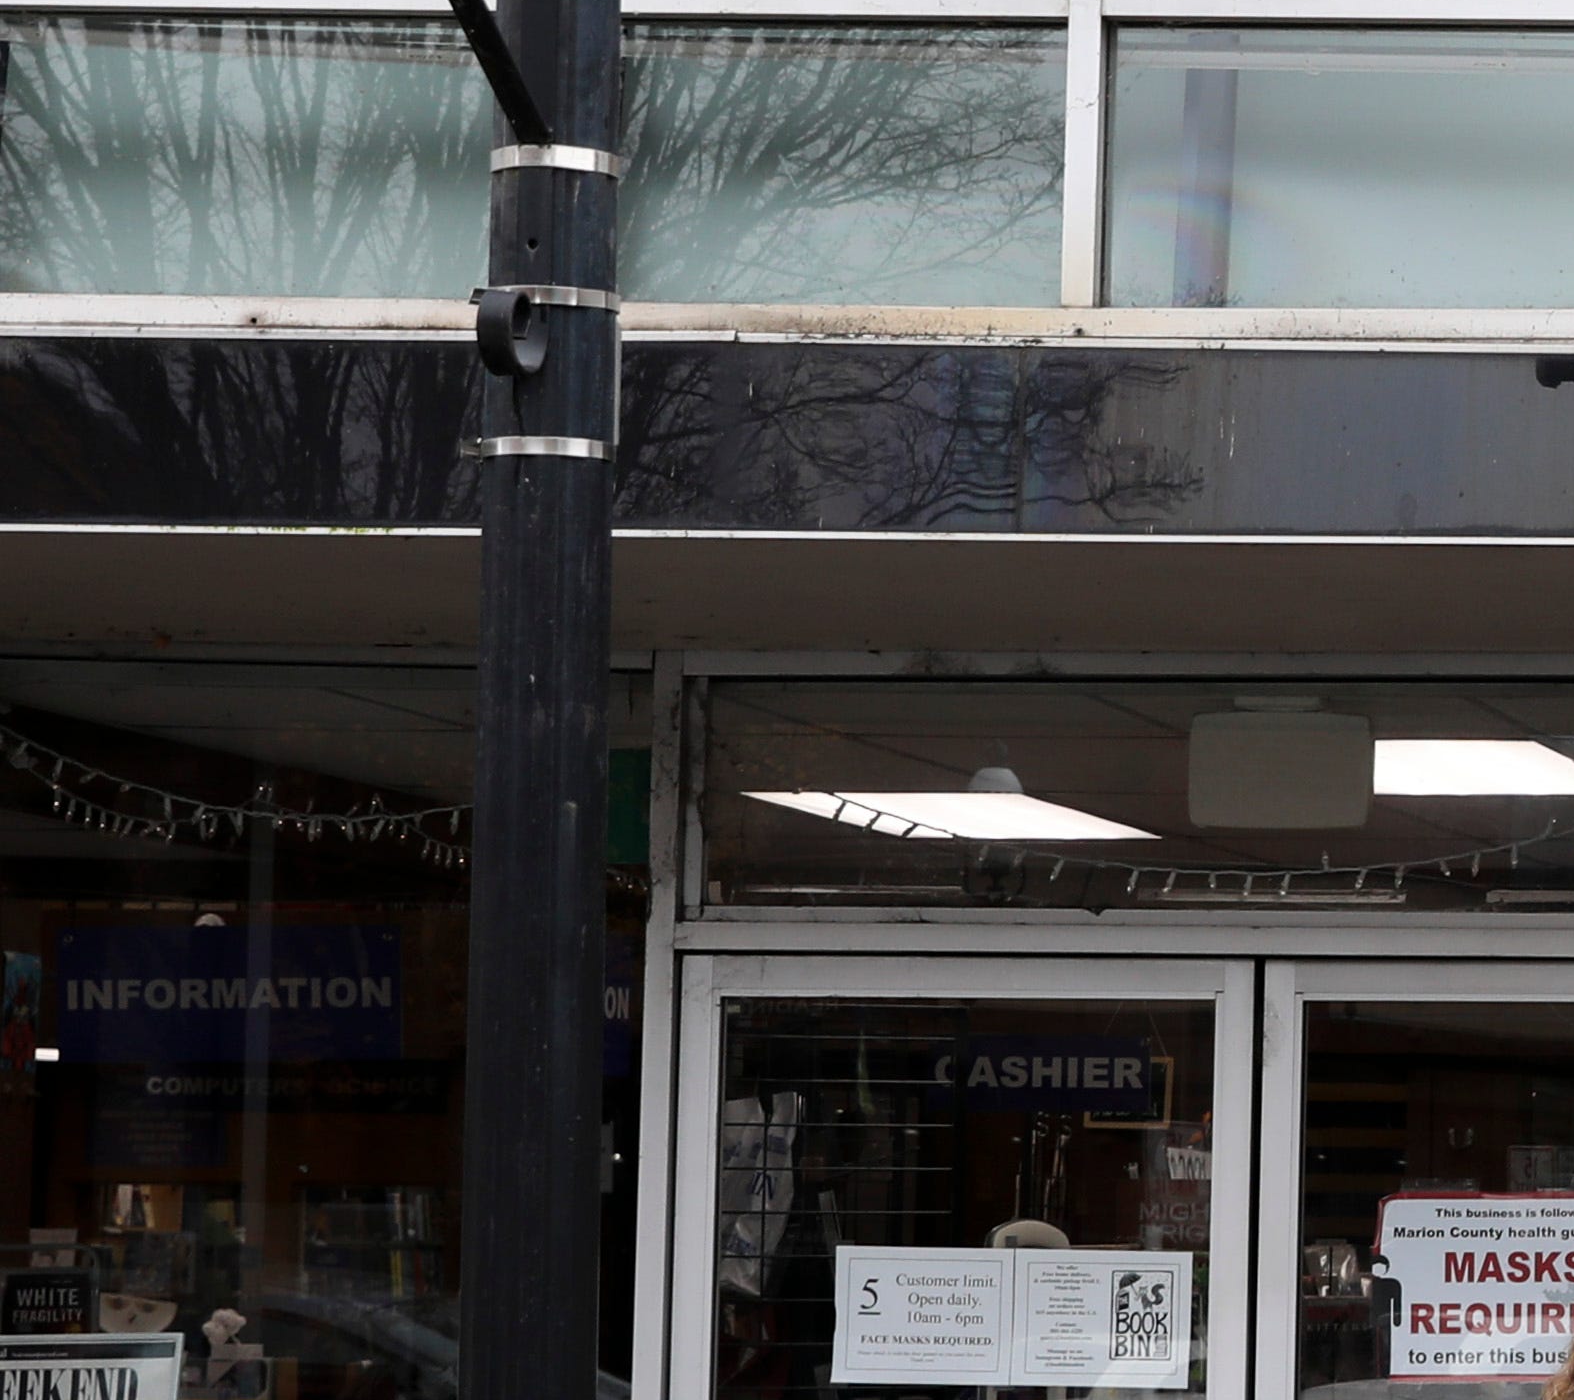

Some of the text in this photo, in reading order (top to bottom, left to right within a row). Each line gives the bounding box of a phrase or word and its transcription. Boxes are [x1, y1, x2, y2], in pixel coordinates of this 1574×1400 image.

[65, 976, 394, 1010] INFORMATION
[934, 1055, 1144, 1089] CASHIER
[1436, 1208, 1462, 1218] This
[1466, 1208, 1522, 1218] business
[1526, 1208, 1537, 1218] is
[1393, 1227, 1445, 1238] Marion
[1450, 1228, 1503, 1241] County
[1508, 1227, 1556, 1238] health
[896, 1274, 998, 1288] Customer limit.
[17, 1288, 79, 1306] WHITE
[908, 1293, 983, 1308] Open daily.
[12, 1308, 82, 1325] FRAGILITY
[906, 1312, 984, 1327] 10am 6pm
[1115, 1312, 1168, 1334] BOOK
[860, 1335, 994, 1346] FACE MASKS REQUIRED.
[1114, 1336, 1150, 1357] BIN
[1408, 1351, 1427, 1364] to
[1433, 1351, 1482, 1364] enter
[1490, 1349, 1525, 1363] this
